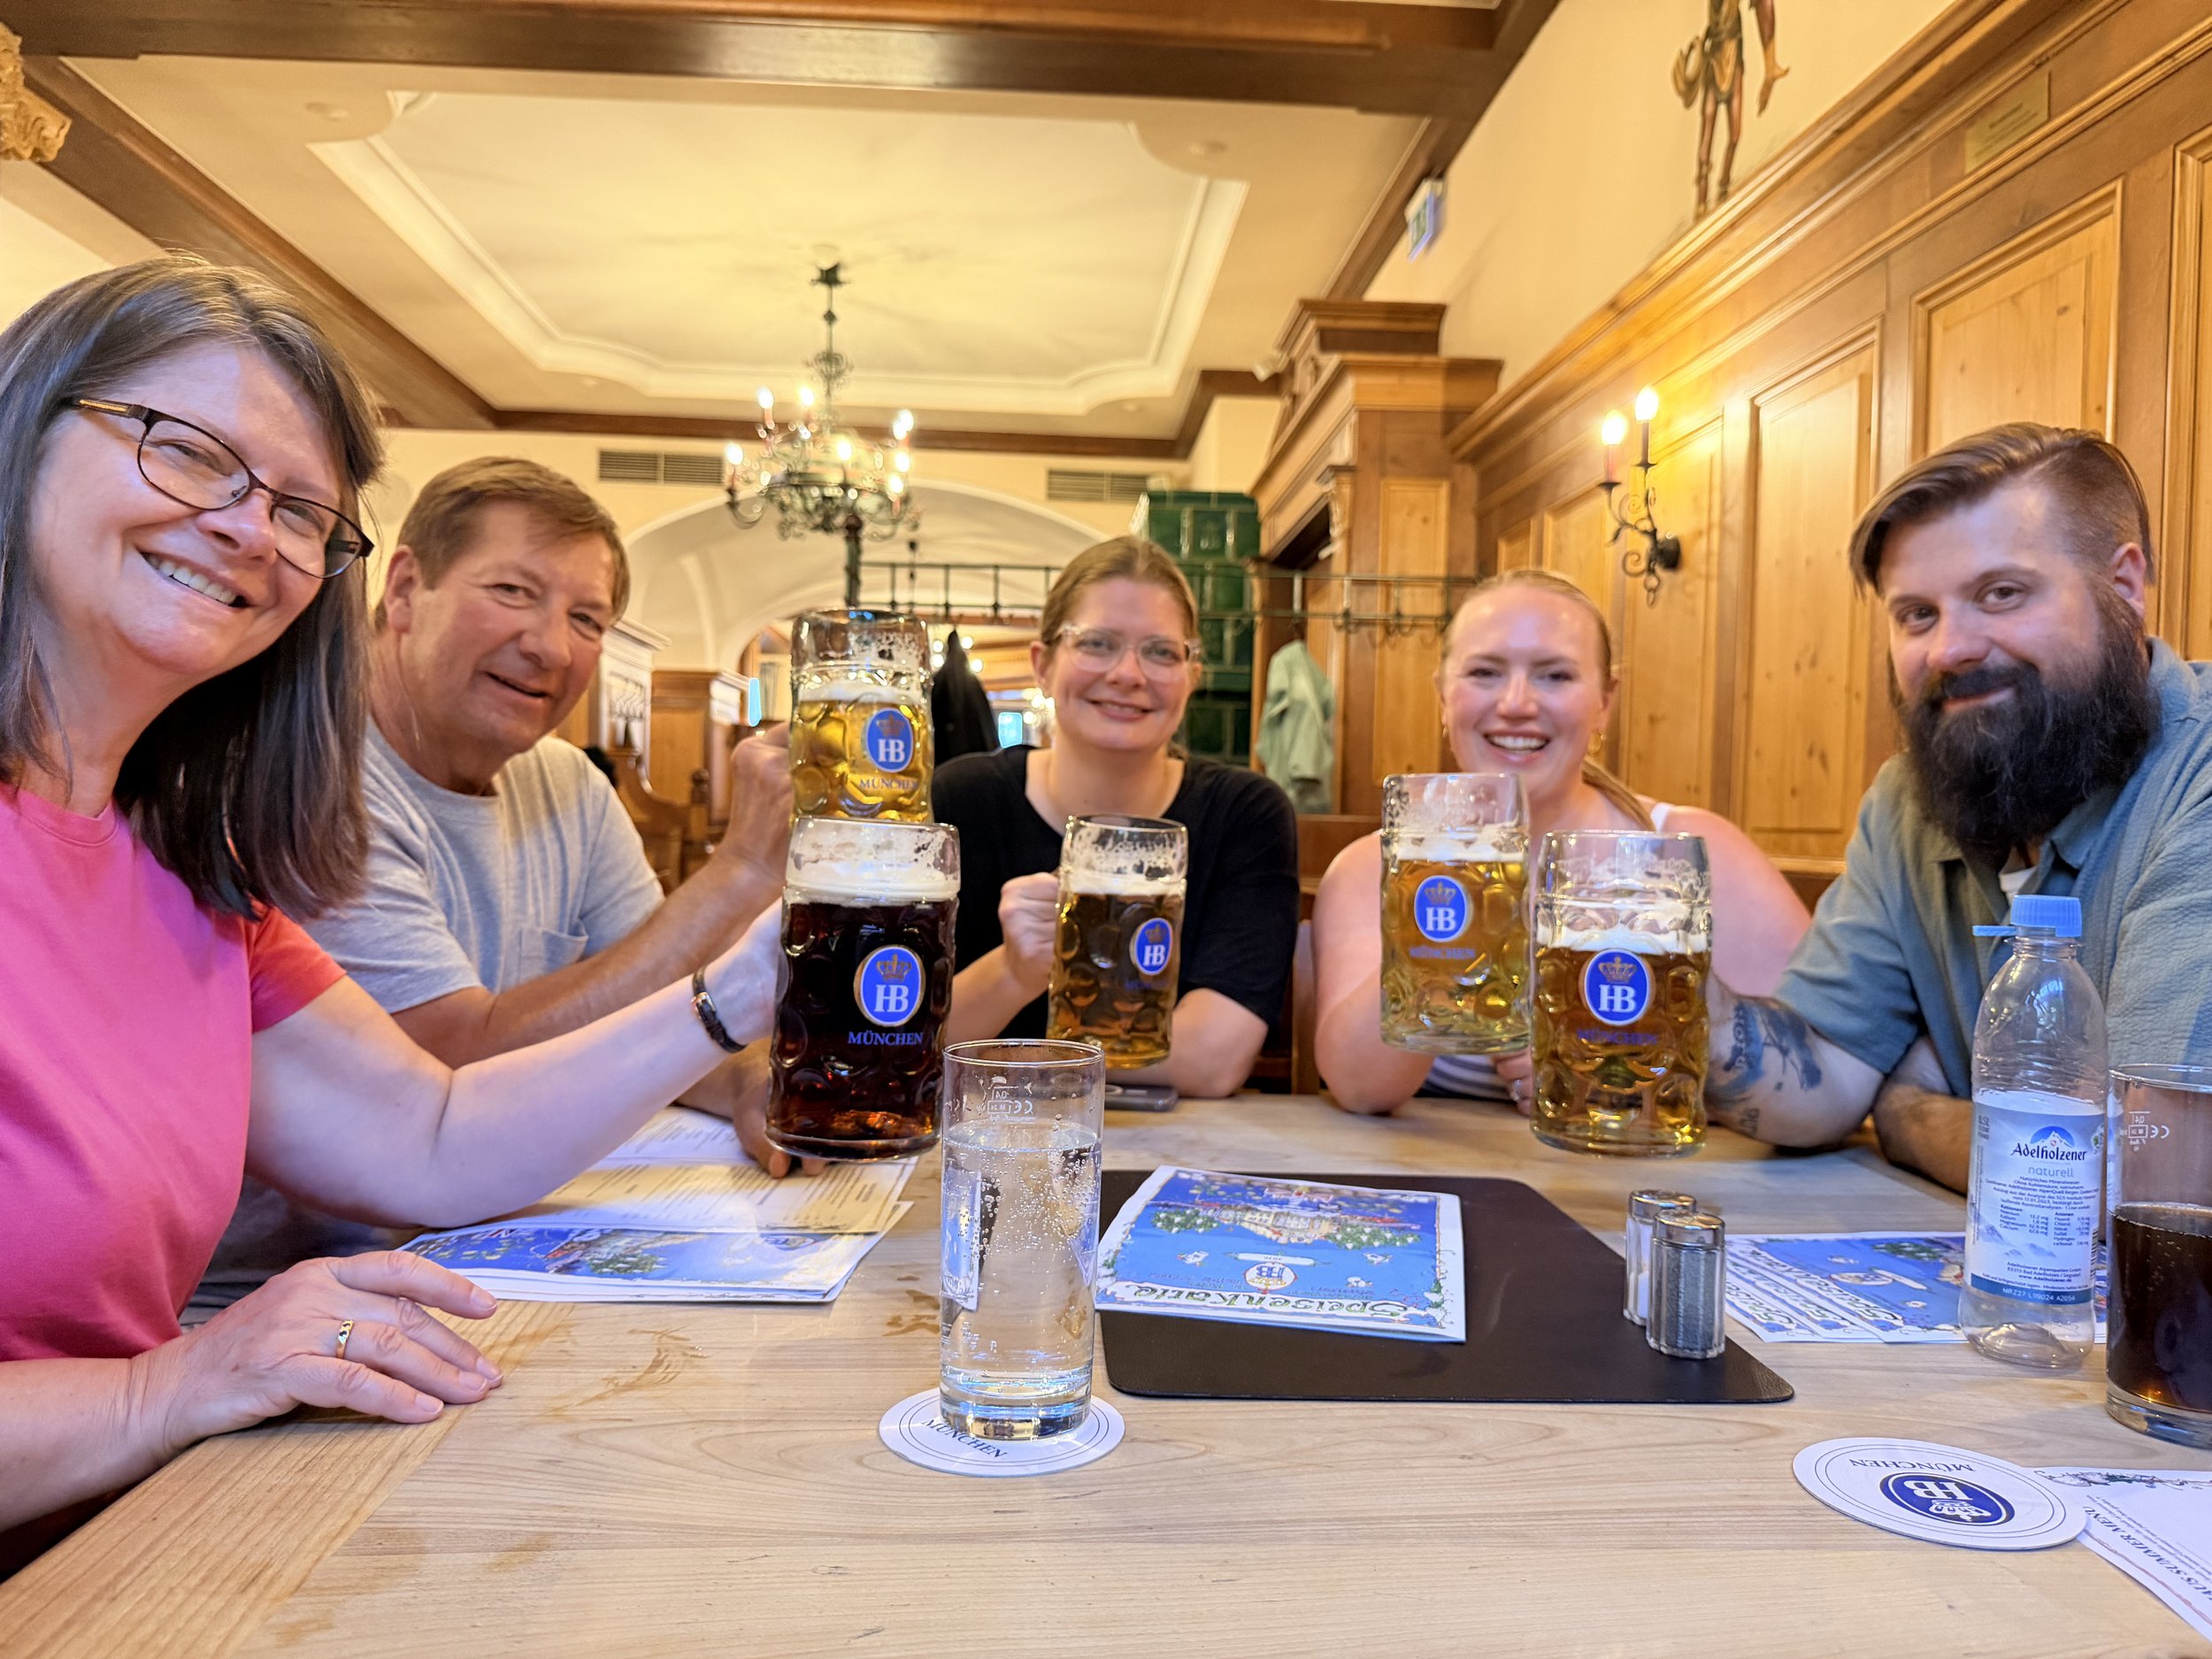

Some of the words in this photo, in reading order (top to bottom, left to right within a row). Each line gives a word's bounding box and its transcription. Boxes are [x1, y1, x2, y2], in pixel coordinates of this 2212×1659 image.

[878, 738, 906, 763] HB
[1425, 906, 1456, 932] HB
[1142, 944, 1166, 966] HB
[873, 984, 910, 1012] HB
[1598, 984, 1636, 1013] HB
[848, 1029, 924, 1046] MÜNCHEN
[2009, 1142, 2087, 1161] Adelholzener
[2028, 1166, 2074, 1178] naturell
[1848, 1458, 1976, 1472] MÜNCHEN
[1903, 1479, 1973, 1501] HB
